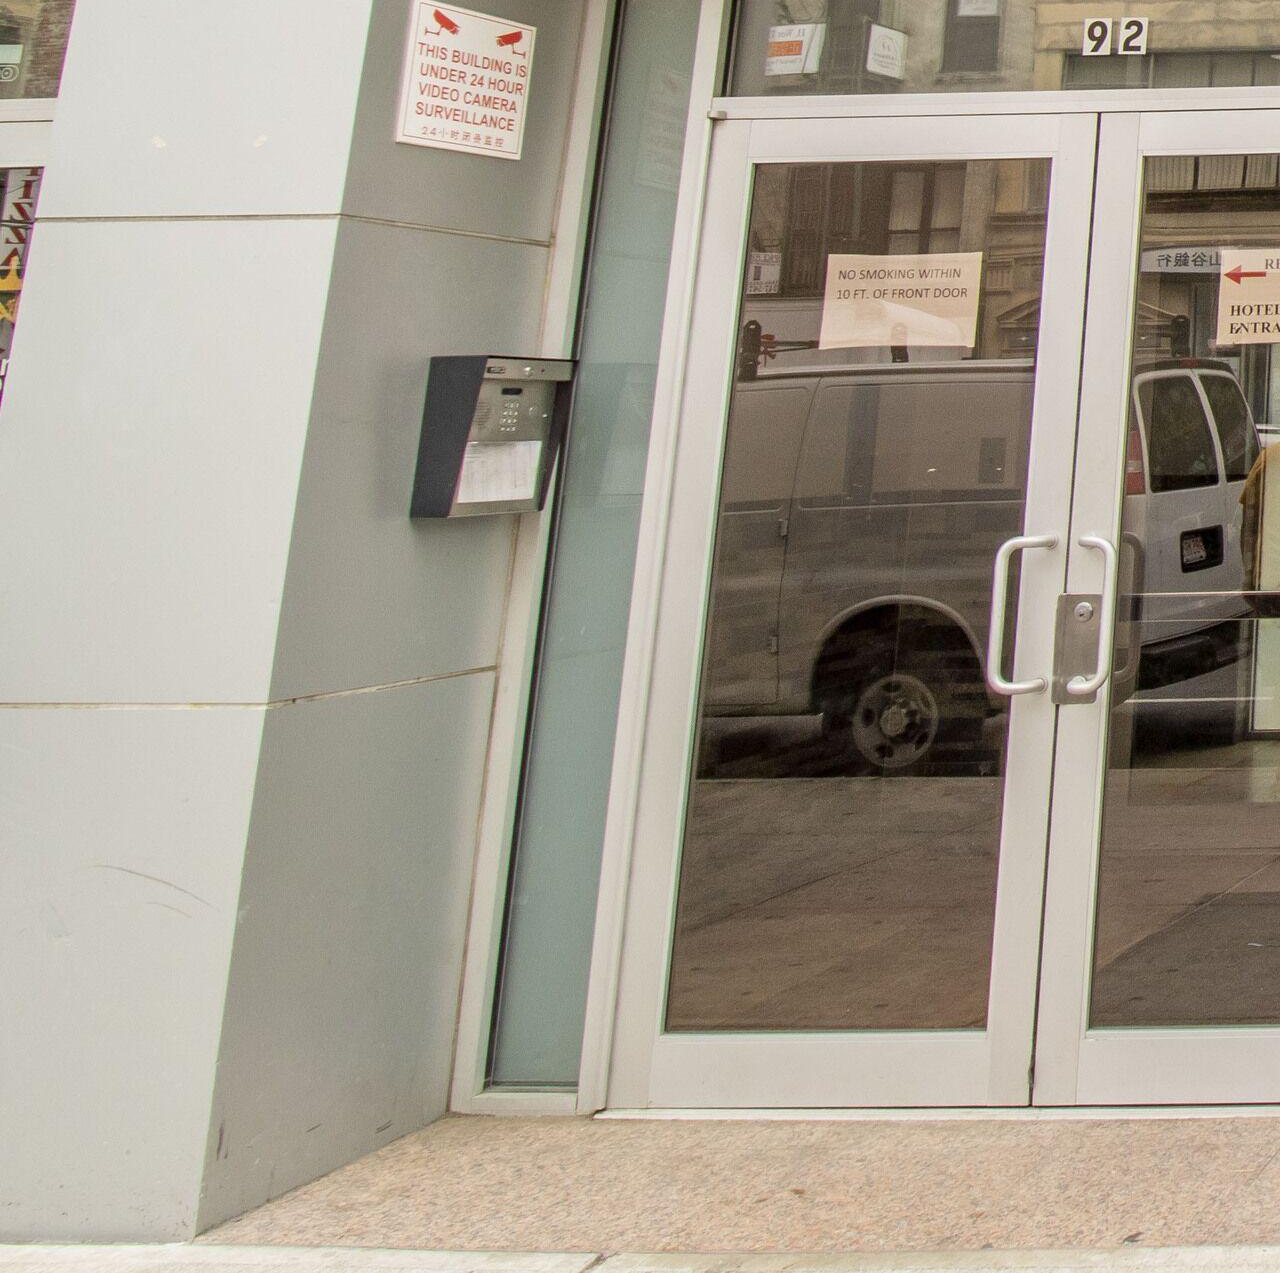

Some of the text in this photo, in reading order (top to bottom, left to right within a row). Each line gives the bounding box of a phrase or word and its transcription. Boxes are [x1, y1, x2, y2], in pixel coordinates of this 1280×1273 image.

[1087, 20, 1143, 52] 92
[418, 42, 527, 77] THIS BUILDING IS
[419, 63, 524, 96] UNDER 24 HOUR
[418, 82, 517, 113] VIDEO CAMERA
[415, 101, 515, 132] SURVEILLANCE
[838, 268, 961, 280] NO SMOKING WITHIN
[836, 287, 968, 300] 10 FT. OF FRONT DOOR
